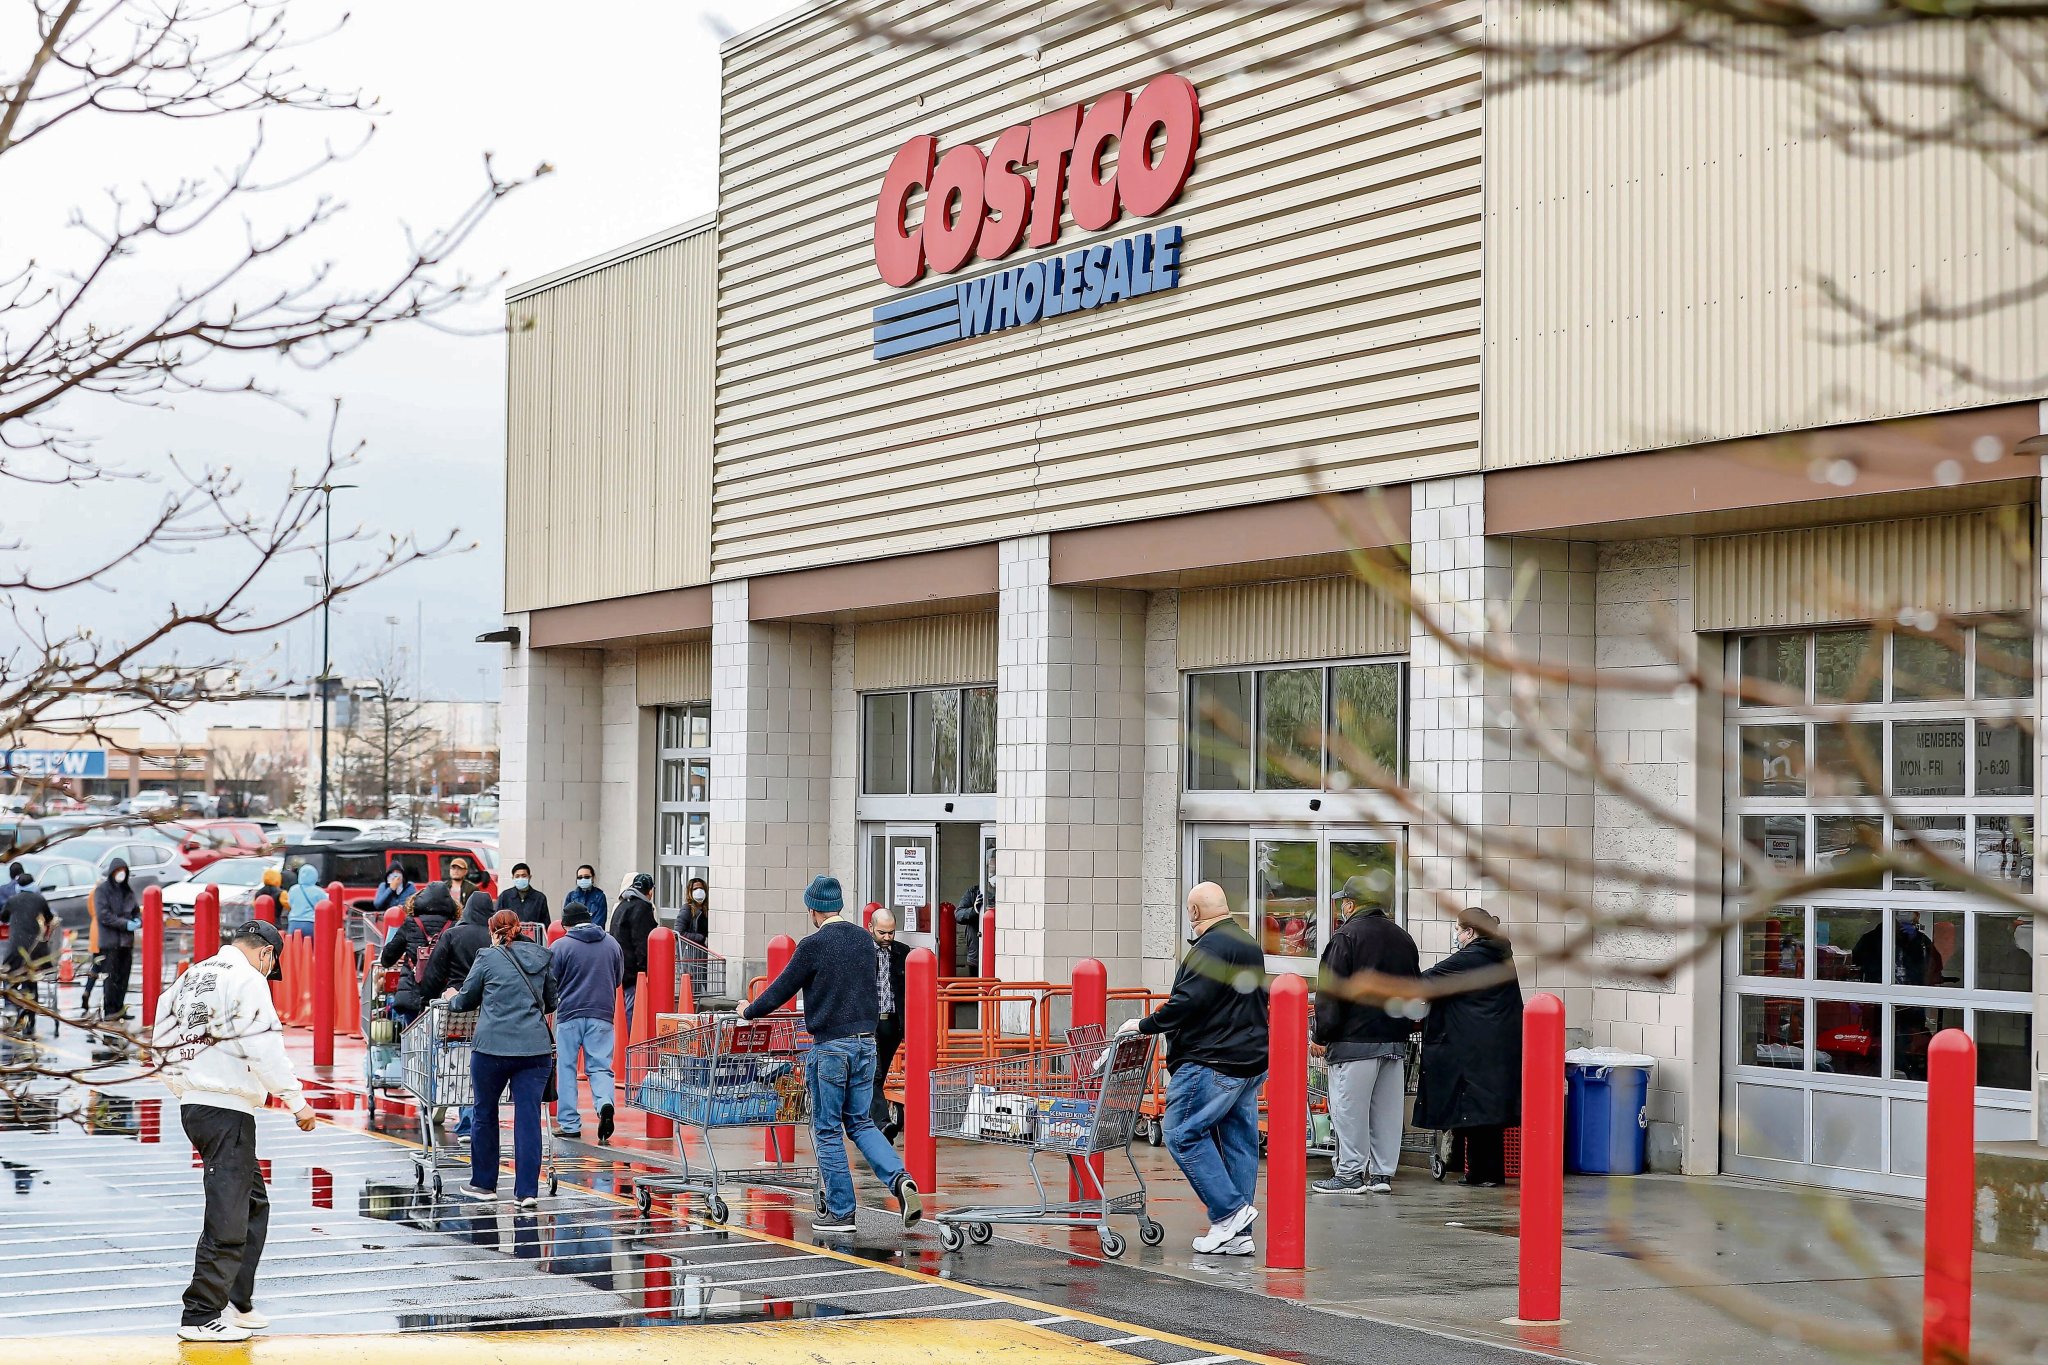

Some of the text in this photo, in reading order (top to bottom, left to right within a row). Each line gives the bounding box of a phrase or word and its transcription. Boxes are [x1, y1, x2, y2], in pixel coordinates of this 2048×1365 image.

[874, 73, 1200, 288] COSTCO
[956, 226, 1182, 339] WHOLESALE
[1916, 731, 1964, 748] MEMBERS
[1900, 760, 1921, 776] MON
[1929, 759, 1944, 775] FRI
[1990, 759, 2010, 775] 6:30
[1049, 1110, 1073, 1118] SCENTED
